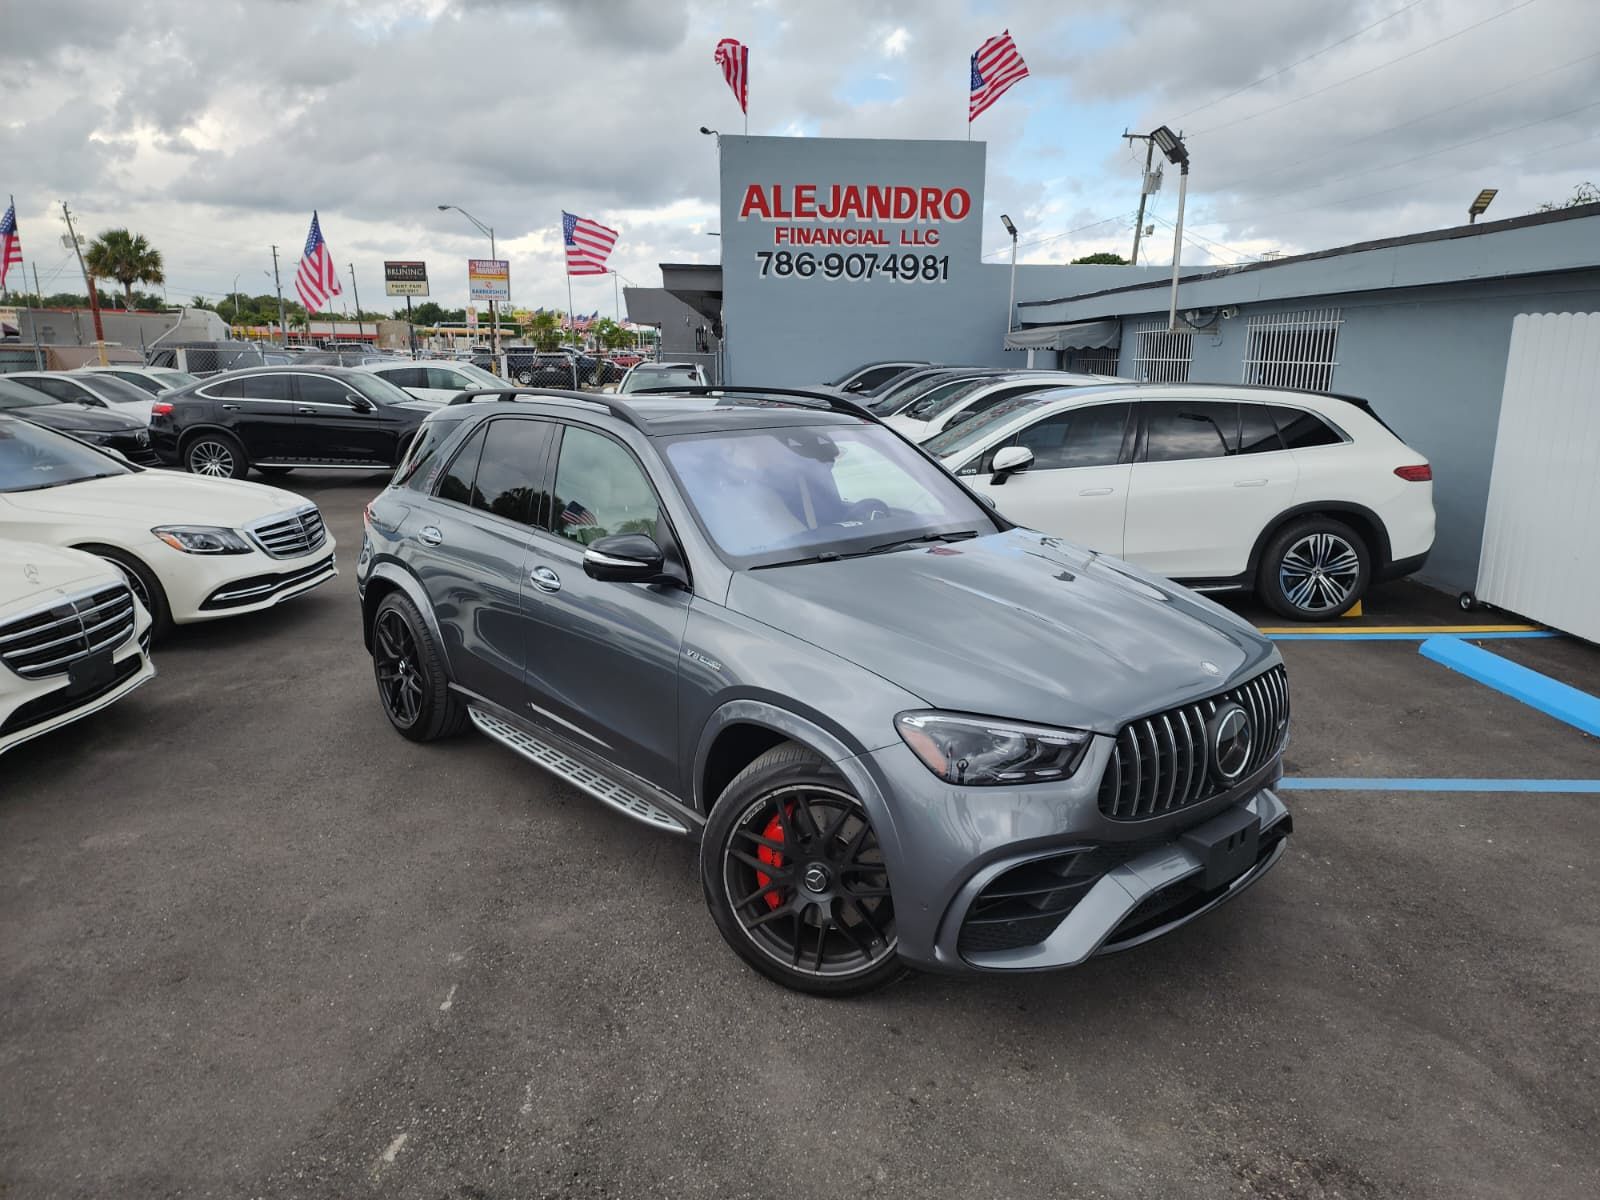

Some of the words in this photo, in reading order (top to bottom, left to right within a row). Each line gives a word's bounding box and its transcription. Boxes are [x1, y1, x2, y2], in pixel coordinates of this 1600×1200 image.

[738, 184, 971, 222] ALEJANDRO
[774, 227, 891, 246] FINANCIAL
[900, 229, 940, 247] LLC
